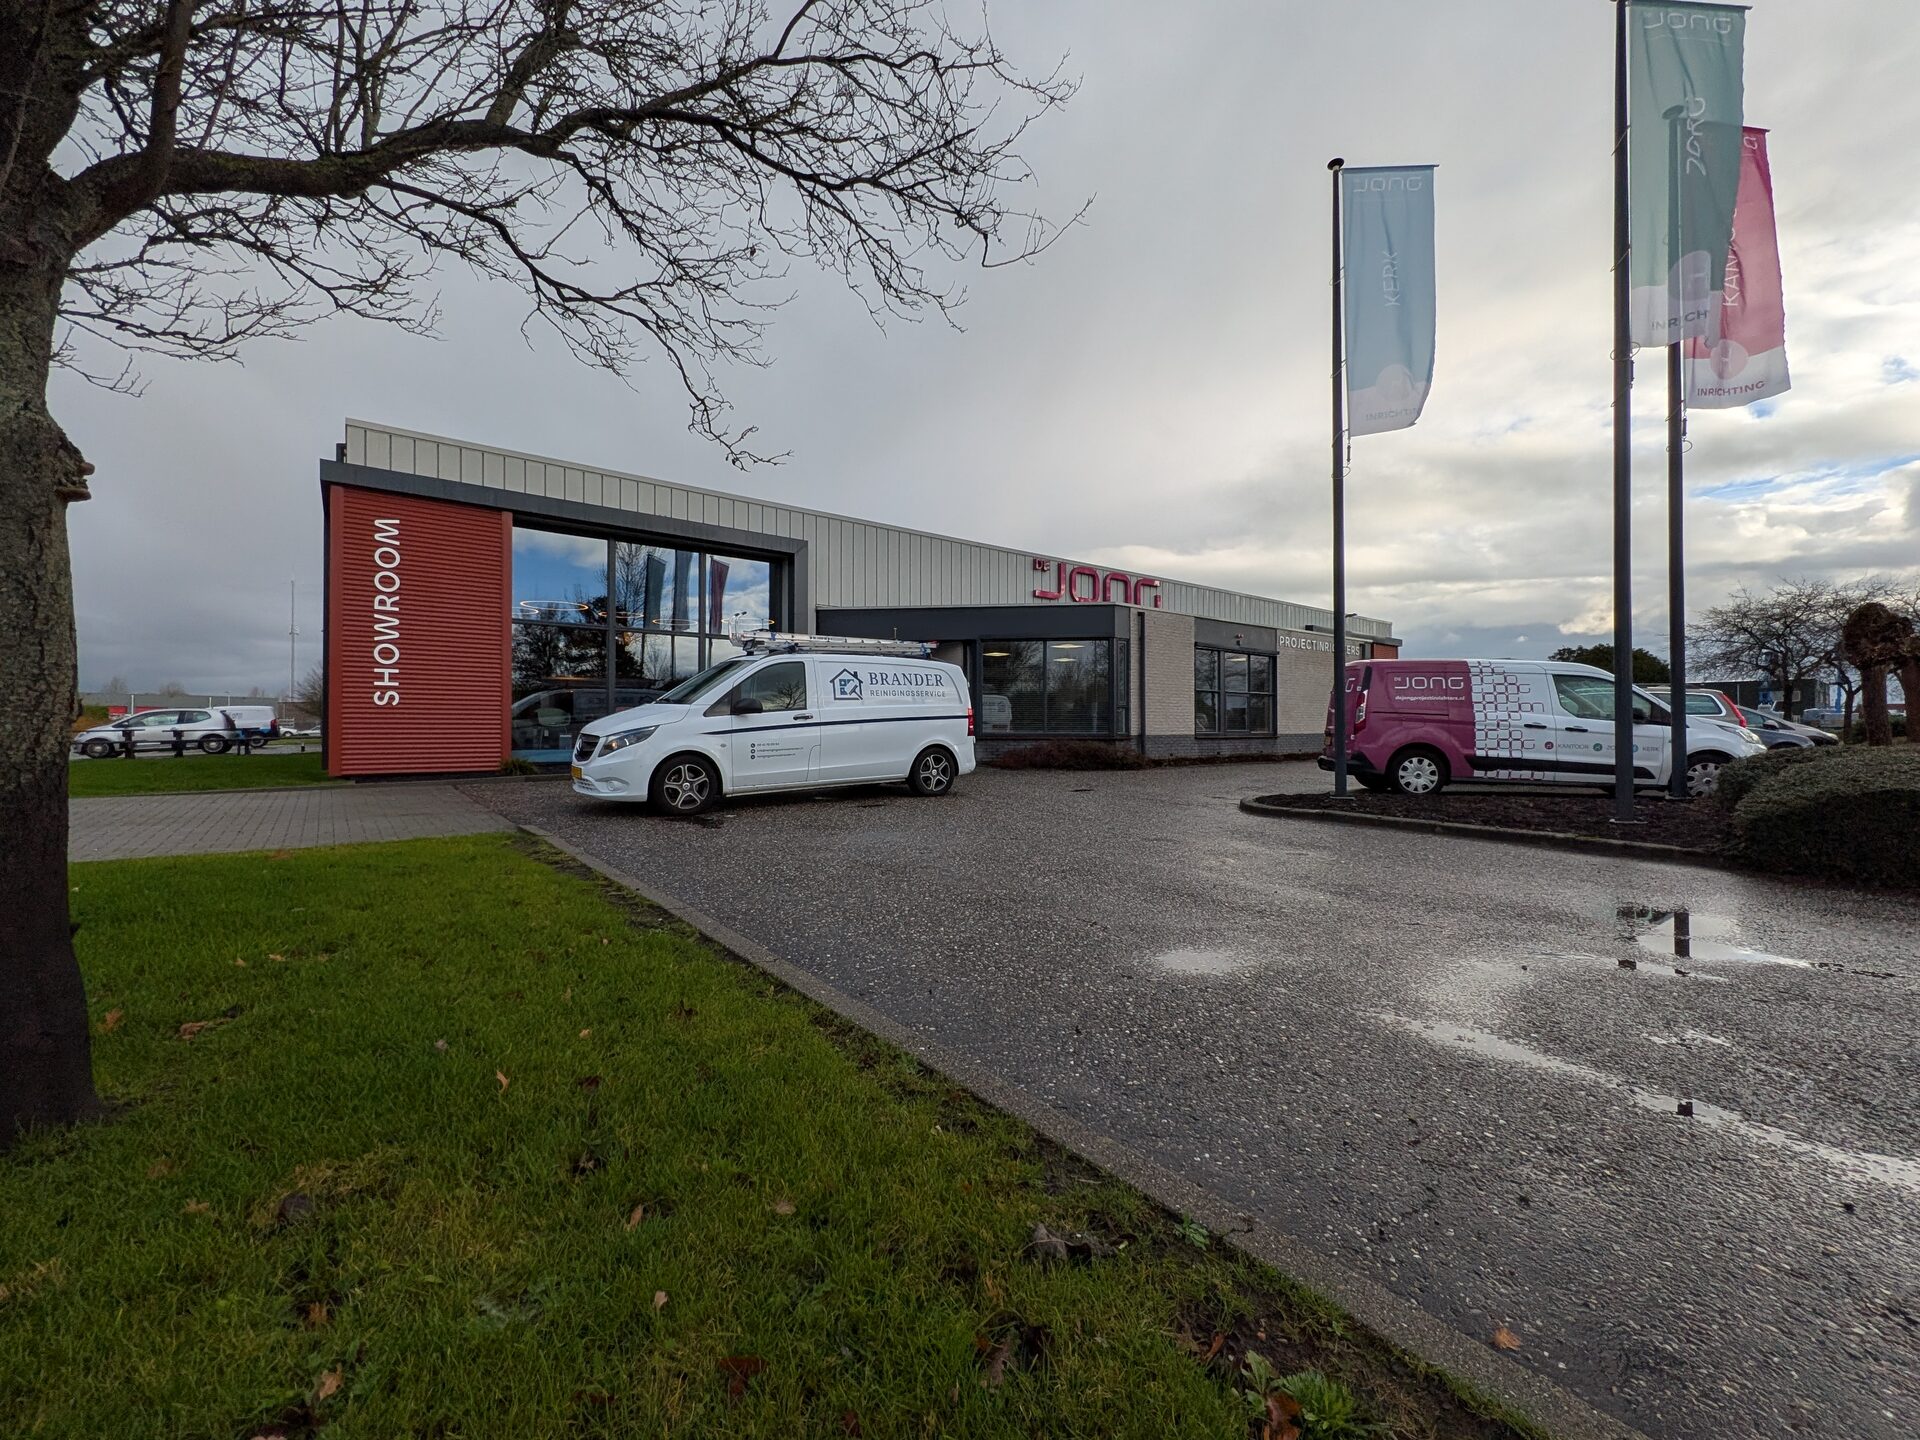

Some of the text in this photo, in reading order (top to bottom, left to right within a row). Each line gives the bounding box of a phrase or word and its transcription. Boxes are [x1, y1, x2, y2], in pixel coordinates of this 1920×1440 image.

[1384, 251, 1401, 307] KERK
[1697, 381, 1765, 397] INRICHTING
[373, 519, 401, 706] SHOWROOM
[868, 672, 944, 687] BRANDER
[870, 689, 946, 698] REINIGINGSSERVICE
